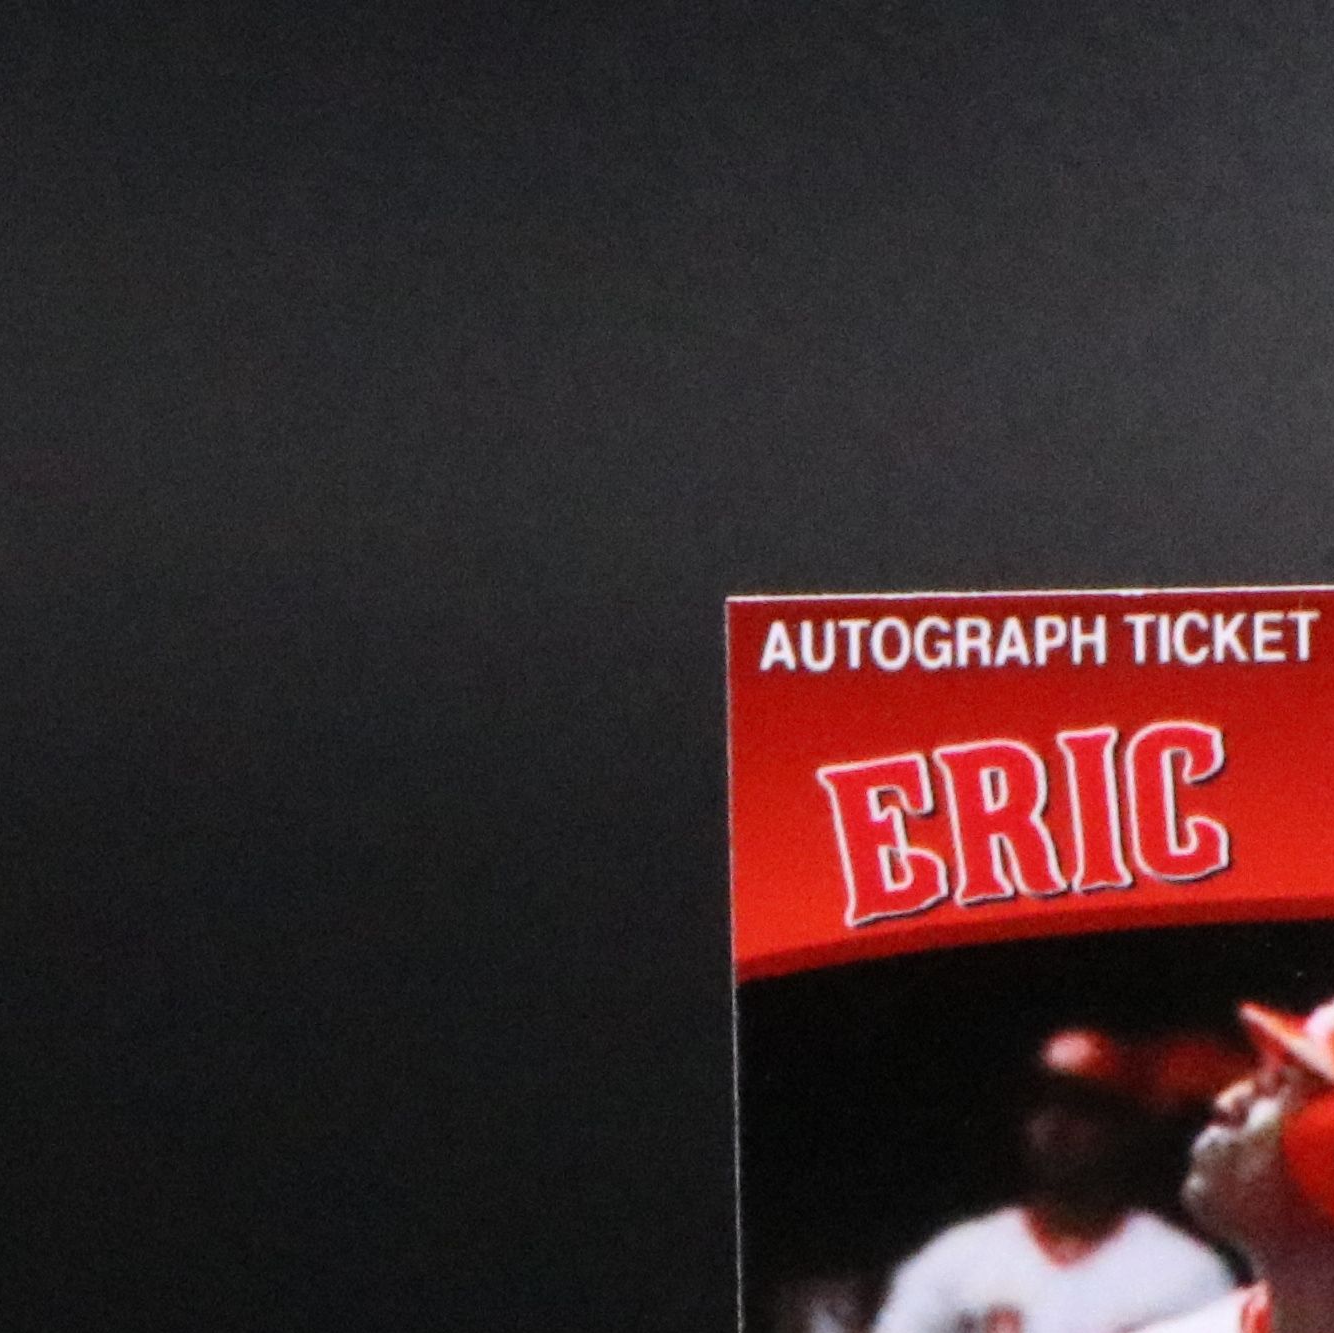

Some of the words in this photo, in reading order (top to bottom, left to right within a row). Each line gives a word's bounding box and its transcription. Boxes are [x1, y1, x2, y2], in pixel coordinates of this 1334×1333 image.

[761, 615, 1106, 671] AUTOGRAPH
[1127, 612, 1318, 665] TICKET
[817, 721, 1228, 927] ERIC
